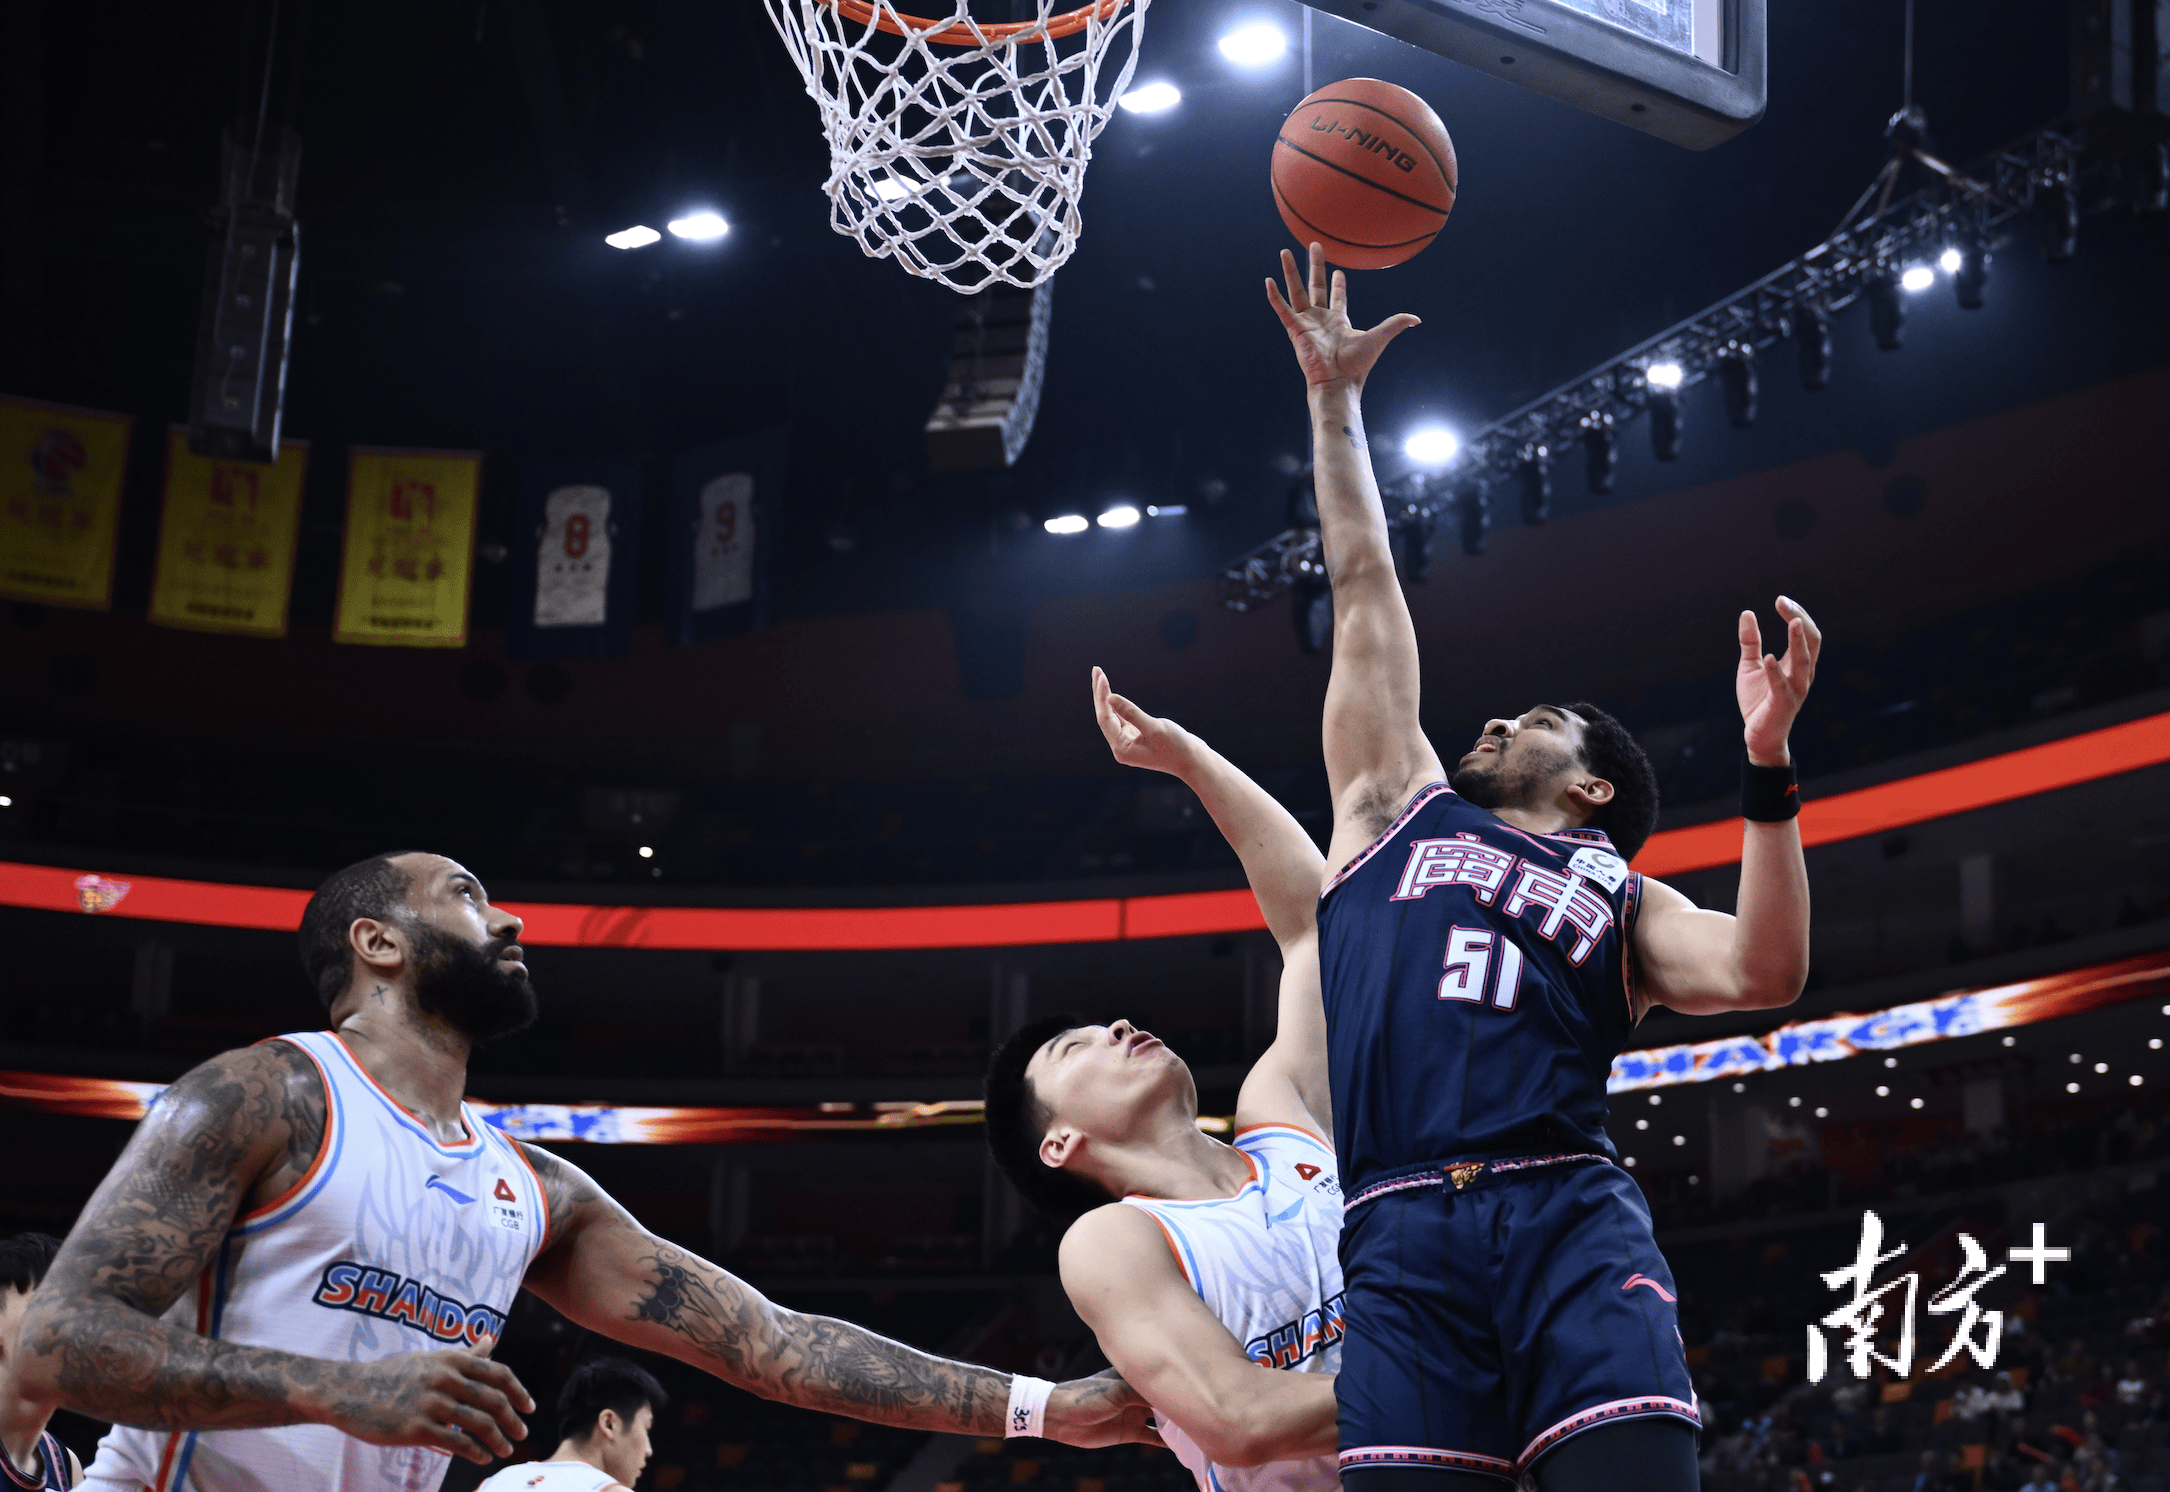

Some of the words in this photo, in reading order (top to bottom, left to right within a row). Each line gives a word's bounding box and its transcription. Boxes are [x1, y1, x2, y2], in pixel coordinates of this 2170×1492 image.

[1310, 115, 1418, 173] LI-NING
[564, 512, 590, 560] 8
[715, 501, 737, 543] 9
[1438, 924, 1524, 1012] 51
[500, 1217, 520, 1230] CGB
